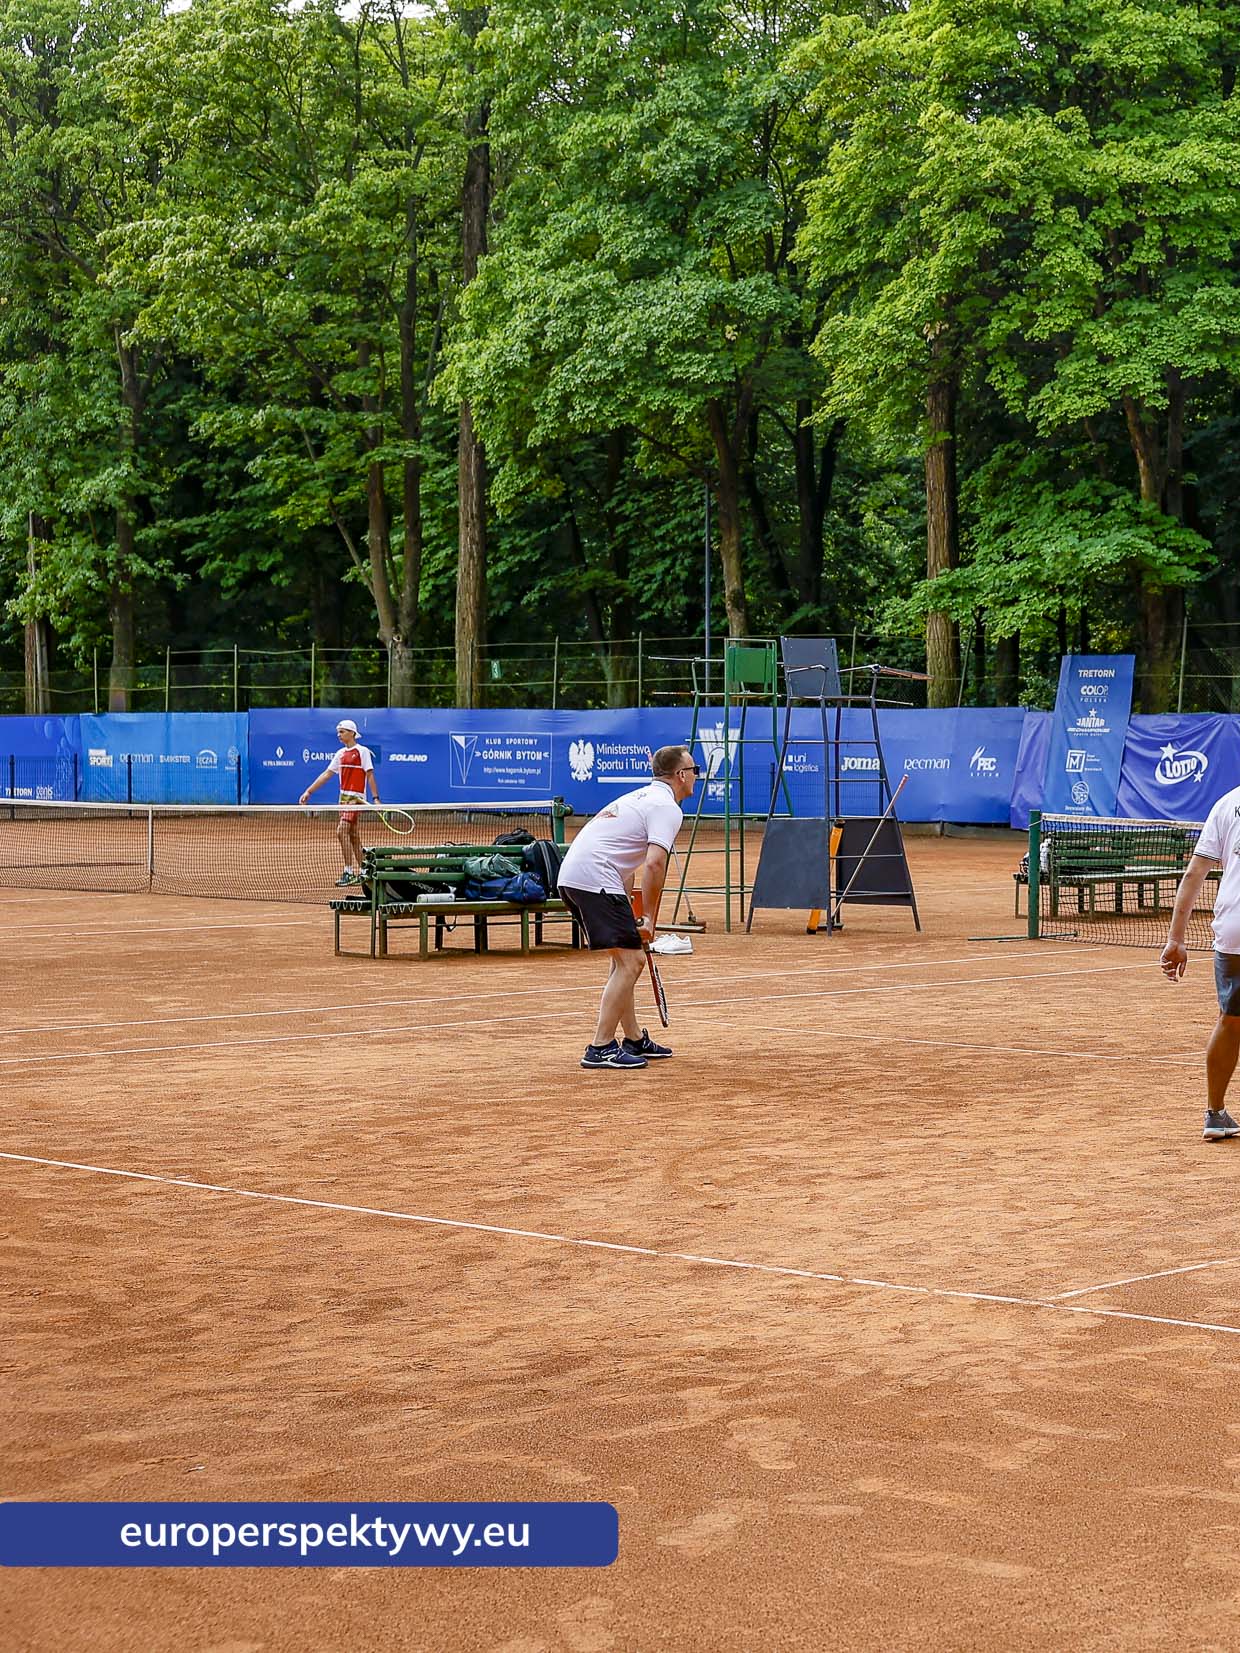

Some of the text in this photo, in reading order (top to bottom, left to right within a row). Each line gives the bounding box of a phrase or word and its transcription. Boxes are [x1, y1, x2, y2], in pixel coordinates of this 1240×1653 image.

[1078, 669, 1116, 678] TRETORN
[506, 738, 538, 746] SPORTOWY
[596, 743, 650, 755] Ministerstwo
[310, 752, 325, 760] CAR
[389, 753, 428, 762] SOLANO
[482, 749, 543, 760] GÓRNIK BYTOM
[793, 753, 807, 763] uni
[596, 758, 623, 772] Sportu
[1164, 757, 1198, 778] LOTTO
